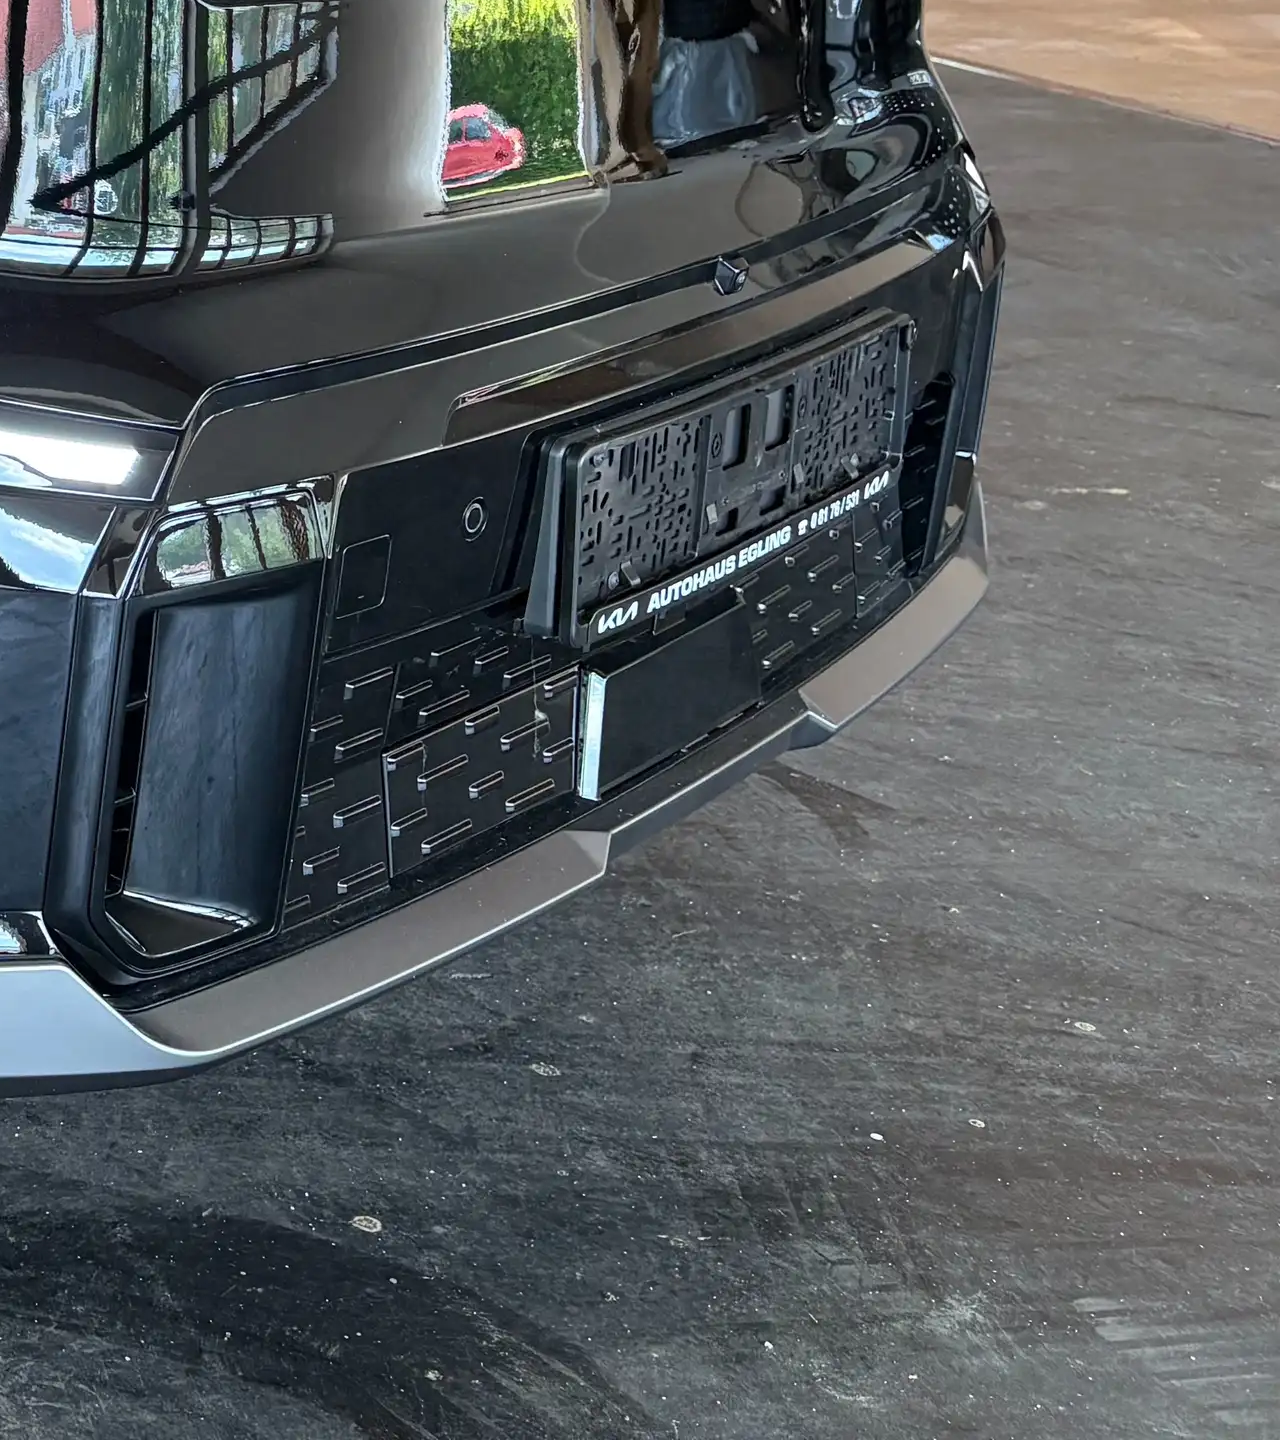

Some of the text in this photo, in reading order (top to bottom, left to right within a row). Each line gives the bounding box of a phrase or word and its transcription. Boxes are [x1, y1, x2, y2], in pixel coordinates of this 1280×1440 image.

[598, 601, 638, 634] KIA
[647, 555, 736, 613] AUTOHAUS
[738, 525, 791, 568] EGLING
[864, 470, 889, 499] KIA
